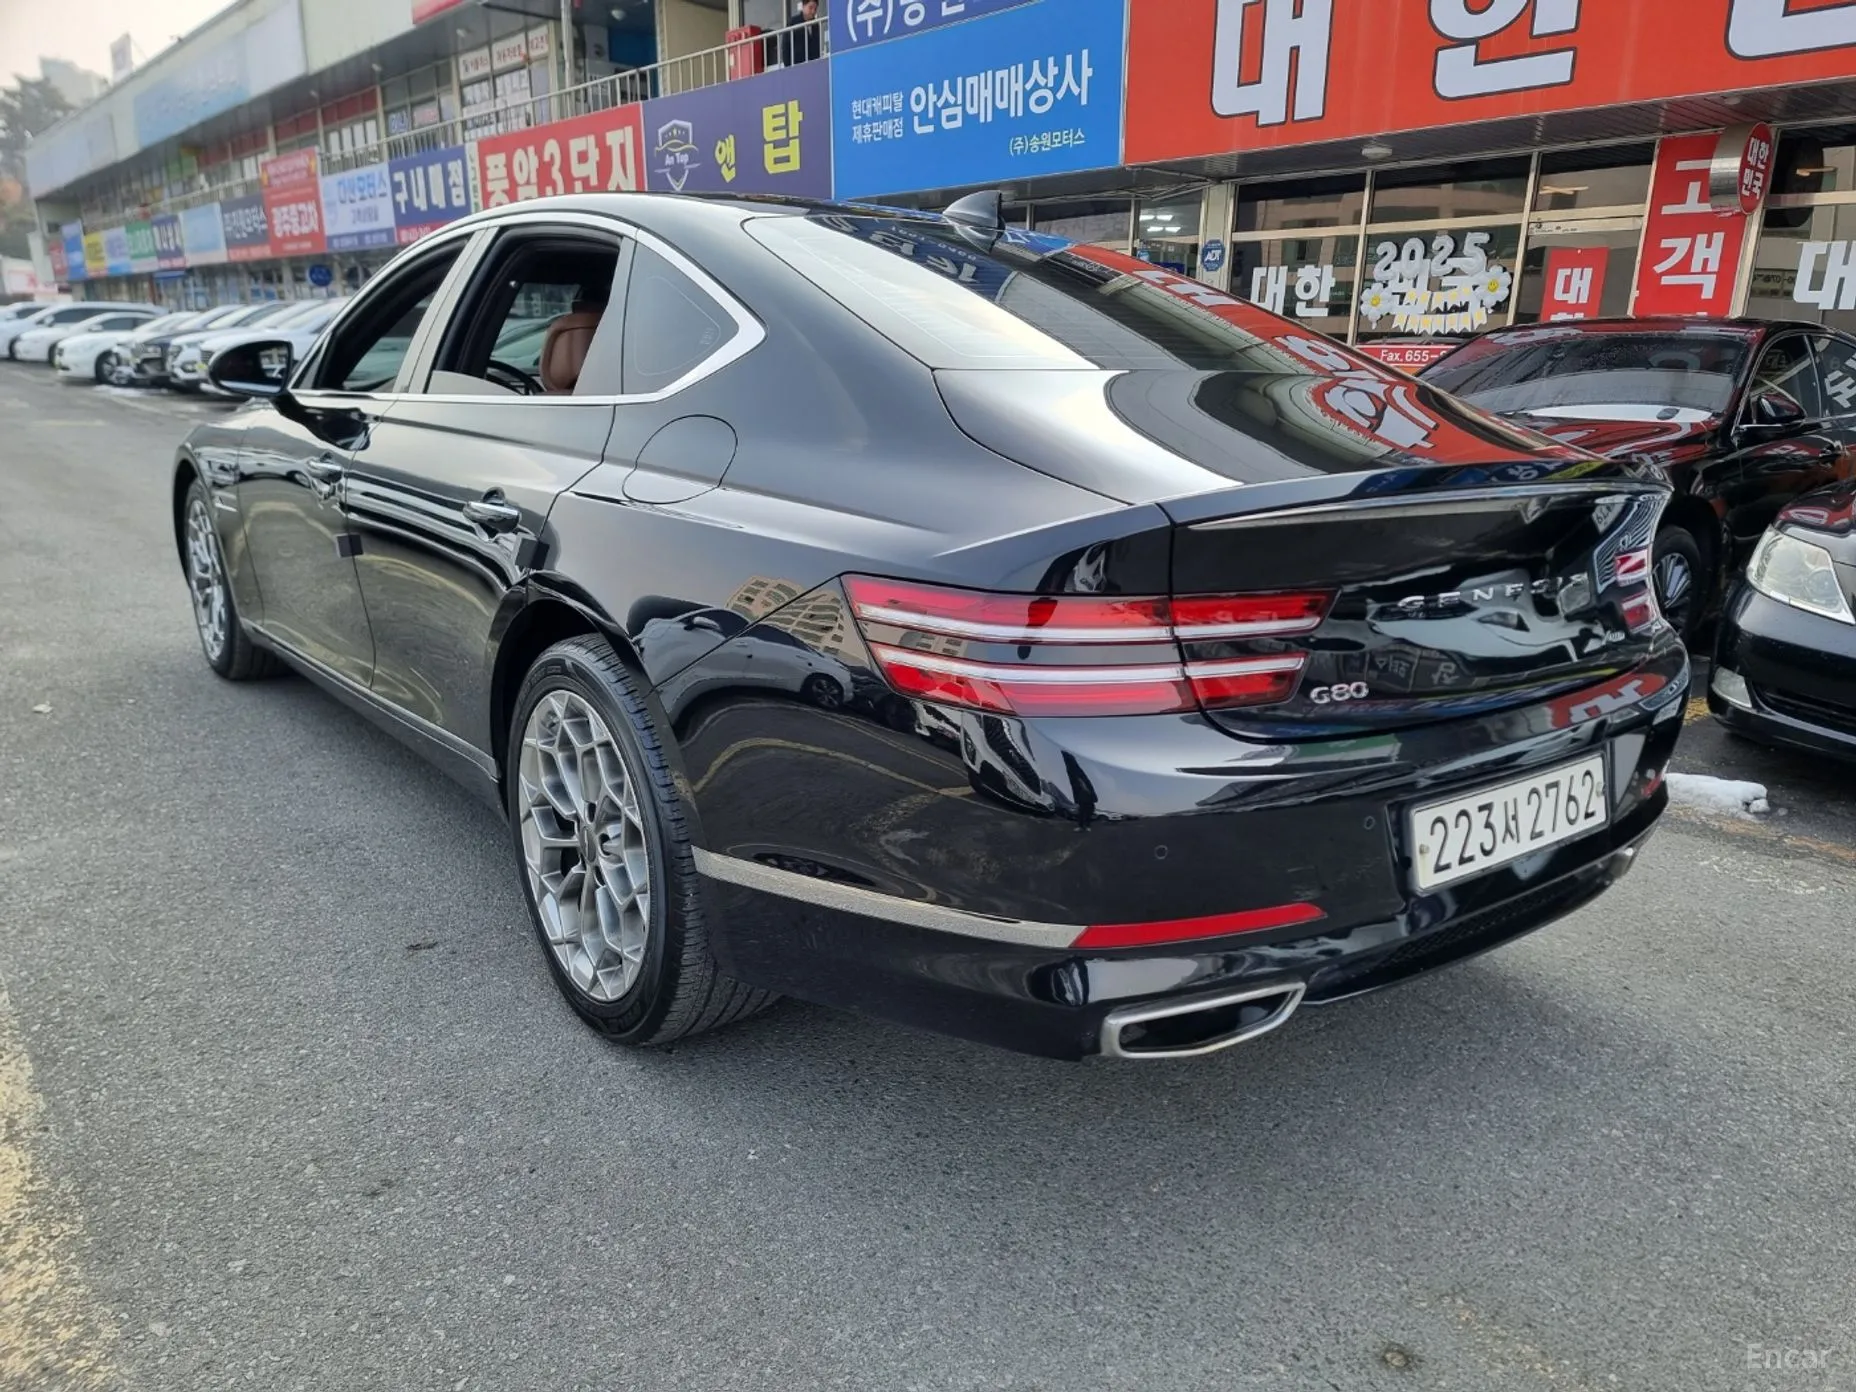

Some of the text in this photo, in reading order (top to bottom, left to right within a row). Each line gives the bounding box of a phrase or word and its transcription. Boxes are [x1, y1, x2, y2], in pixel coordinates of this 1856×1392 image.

[851, 91, 904, 120] 현대캐피탈
[909, 49, 1093, 135] 안심매매상사
[852, 117, 904, 145] 제휴판매점
[1009, 127, 1086, 157] (주)송원모터스
[664, 153, 675, 166] An
[1748, 136, 1771, 170] 대한
[1741, 168, 1765, 200] 민국
[1203, 249, 1222, 263] ADT
[1373, 231, 1491, 282] 2025
[1250, 264, 1337, 317] 대한
[1378, 349, 1404, 363] Fax.
[1309, 681, 1370, 704] G80
